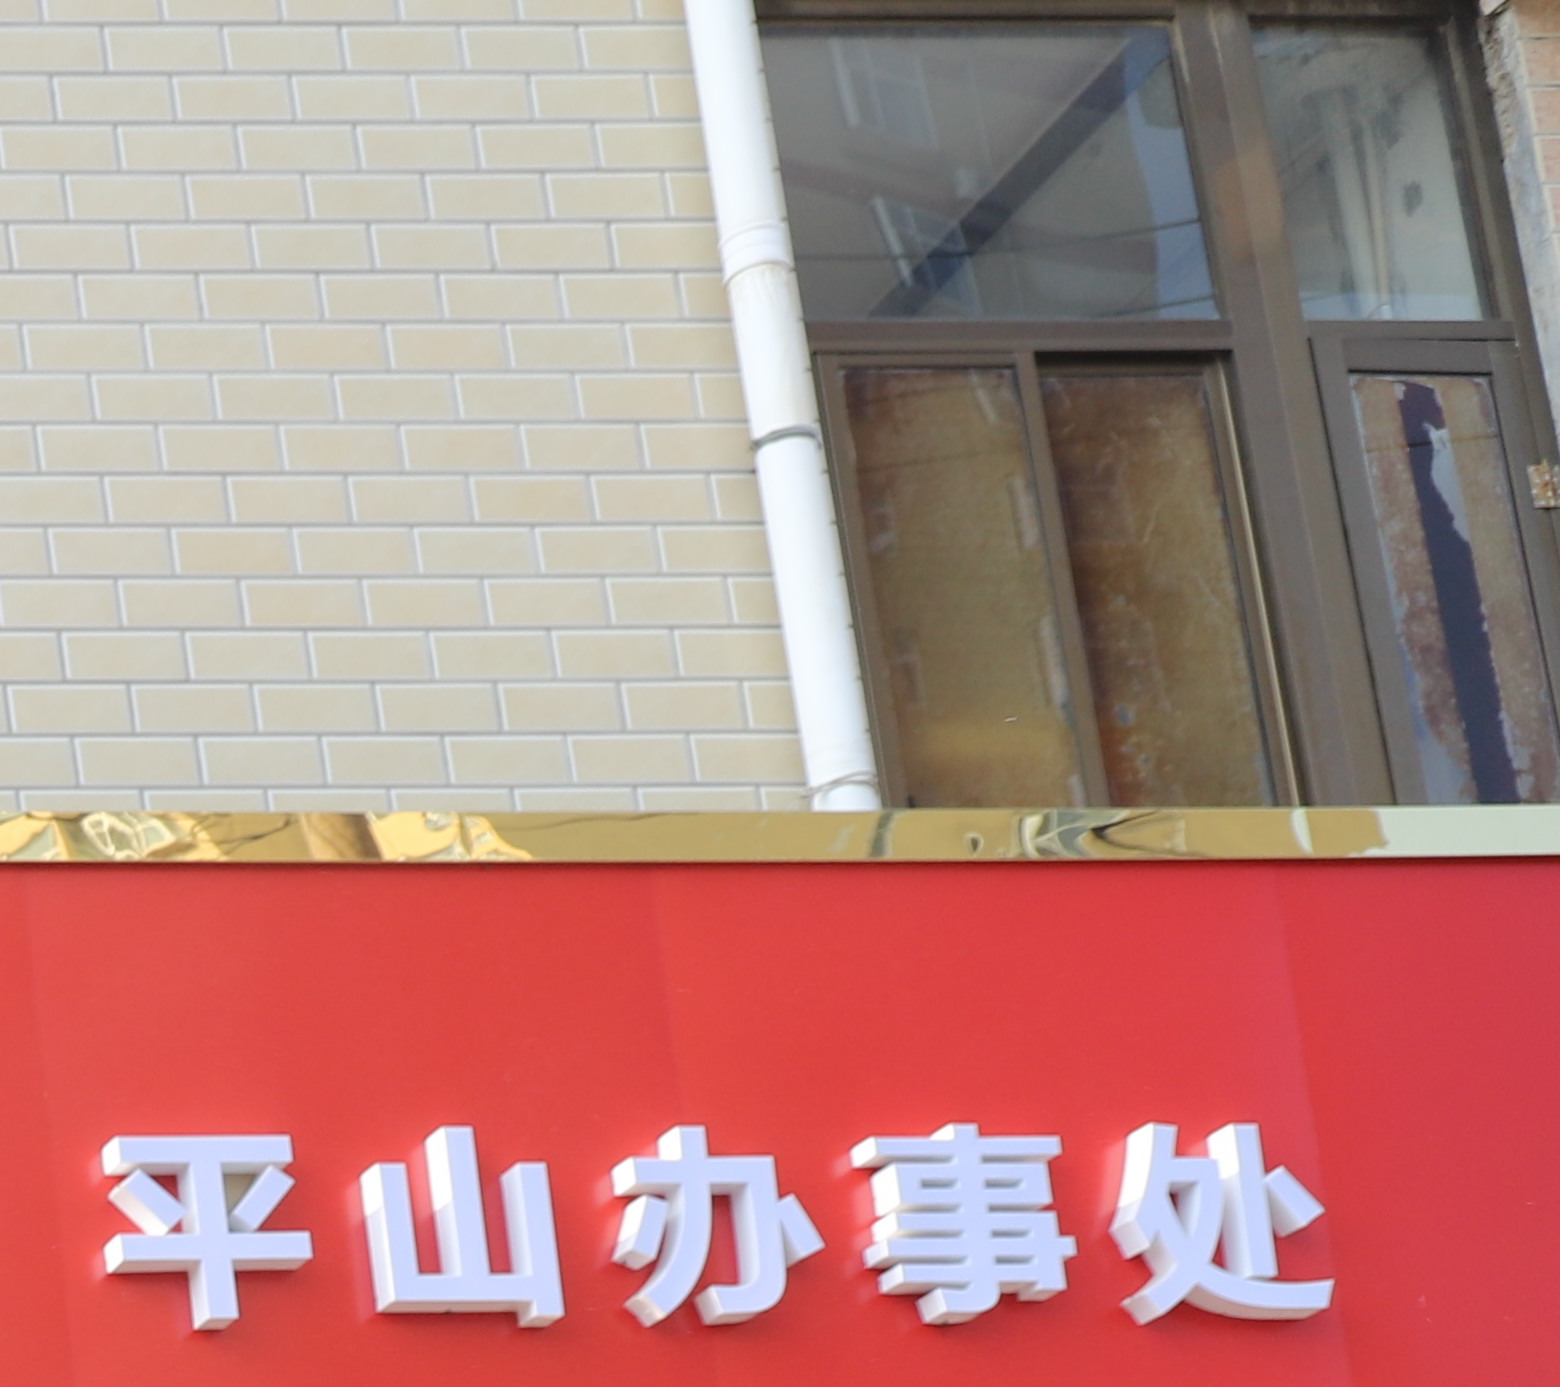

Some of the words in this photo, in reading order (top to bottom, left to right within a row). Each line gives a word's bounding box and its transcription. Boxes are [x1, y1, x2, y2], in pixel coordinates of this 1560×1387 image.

[100, 1122, 1335, 1331] 平山办事处
